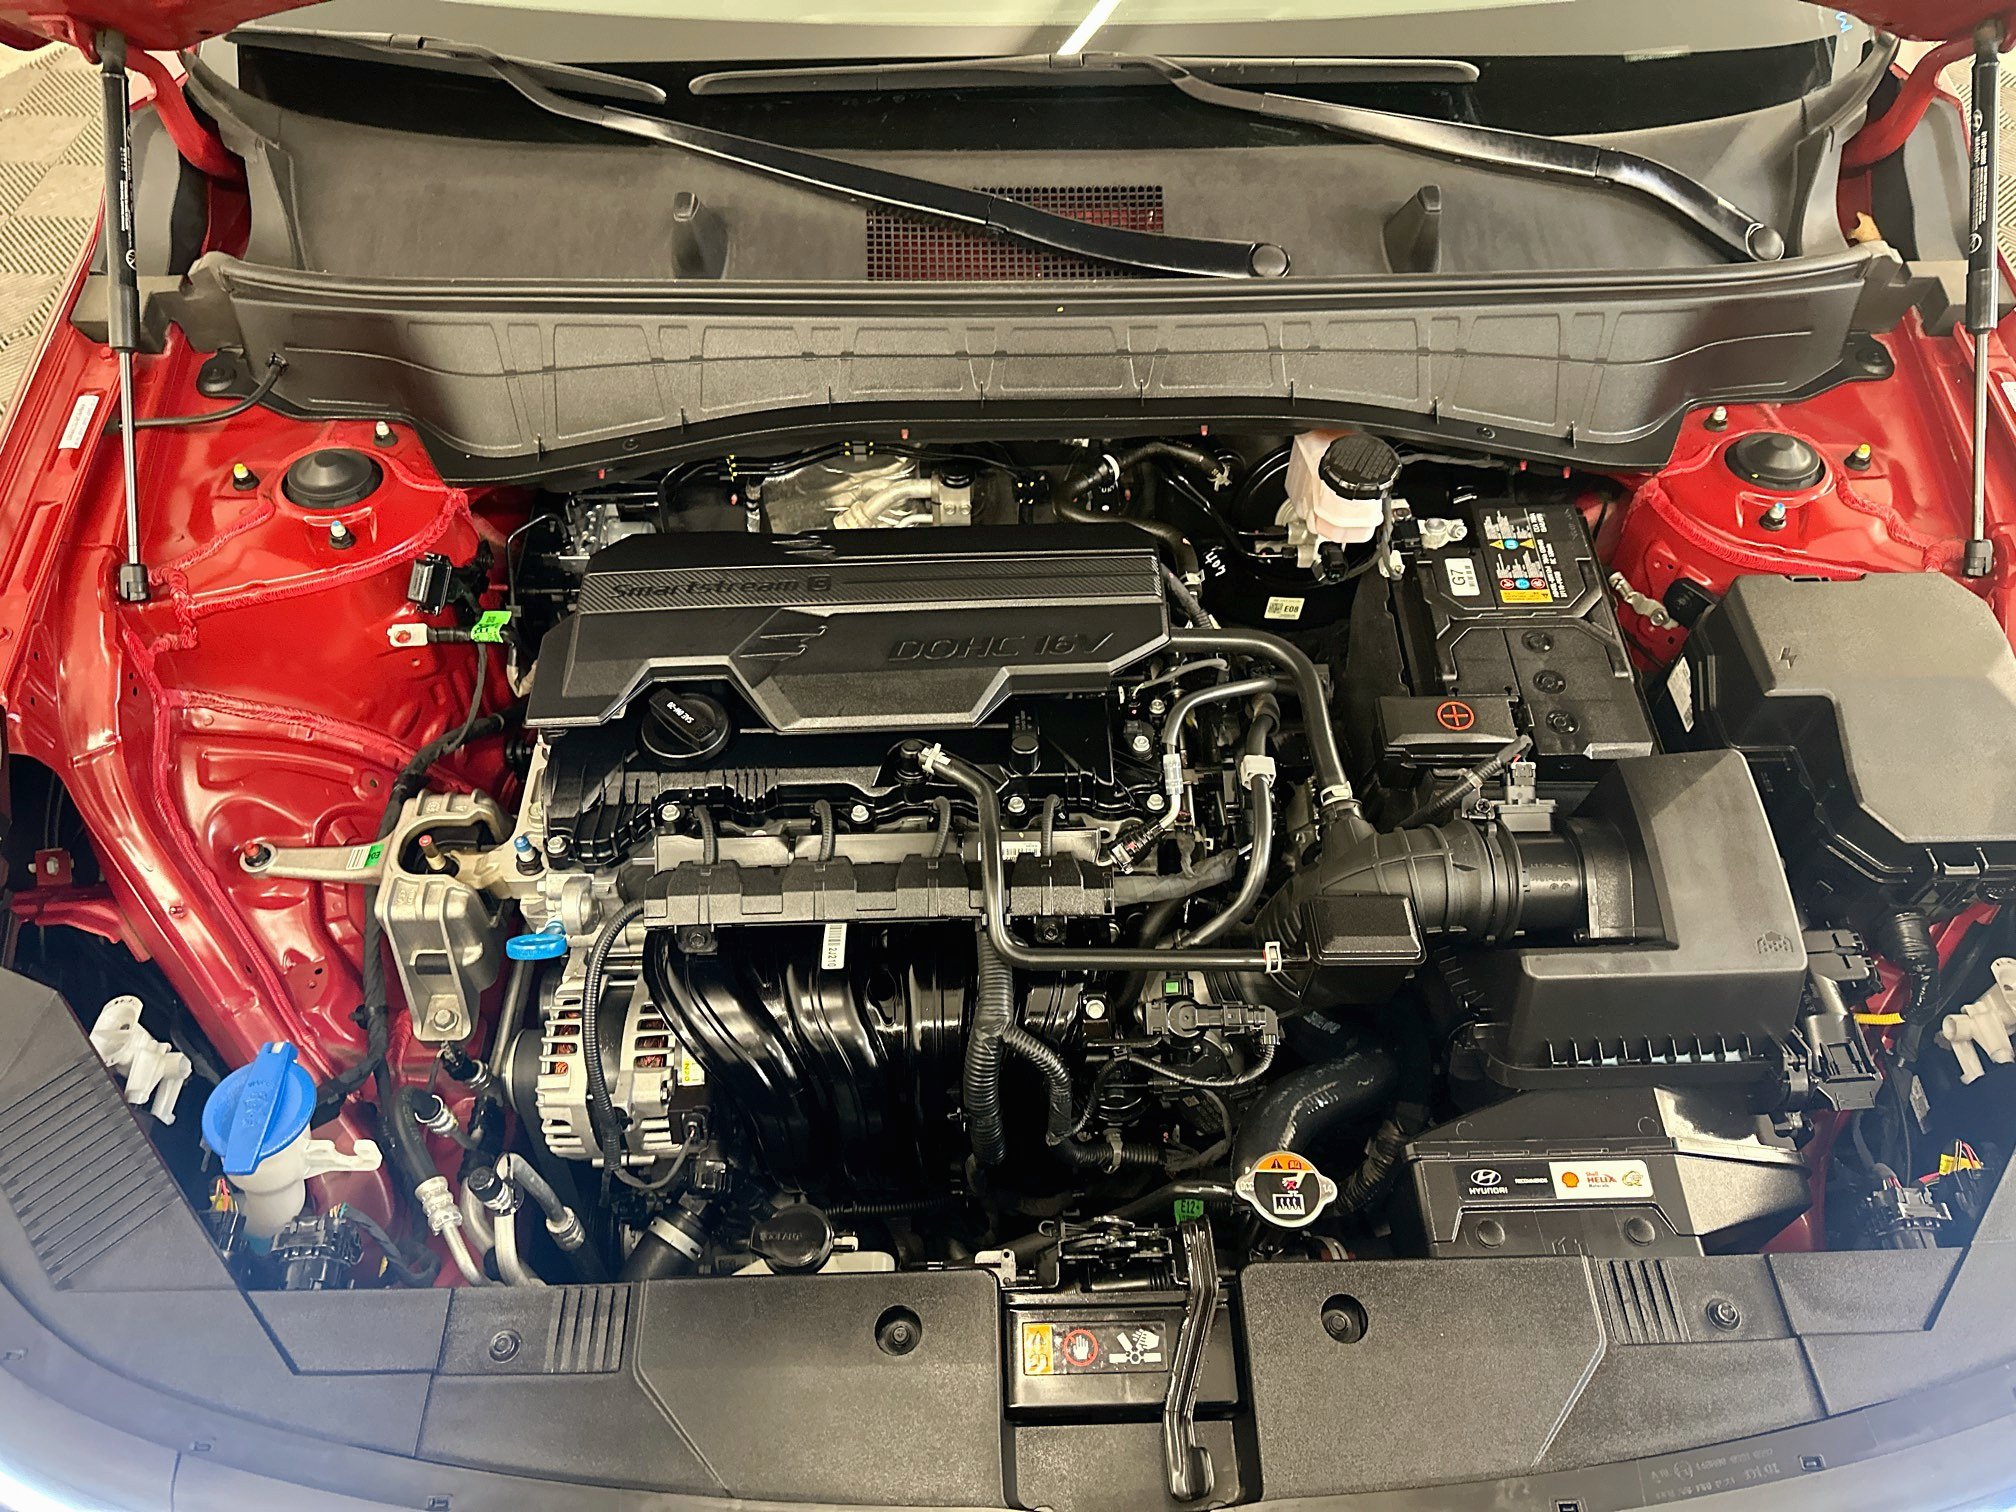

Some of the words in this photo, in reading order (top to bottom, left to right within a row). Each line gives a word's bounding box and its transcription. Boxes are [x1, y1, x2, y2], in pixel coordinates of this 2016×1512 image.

[1450, 569, 1466, 586] G7
[608, 578, 800, 600] Smartstream
[1283, 605, 1299, 613] E08
[888, 635, 1026, 662] DOHC
[1034, 632, 1115, 657] 16V
[681, 712, 695, 724] SAE
[1587, 1175, 1617, 1183] HELIX
[1469, 1186, 1509, 1195] HYUNDAI
